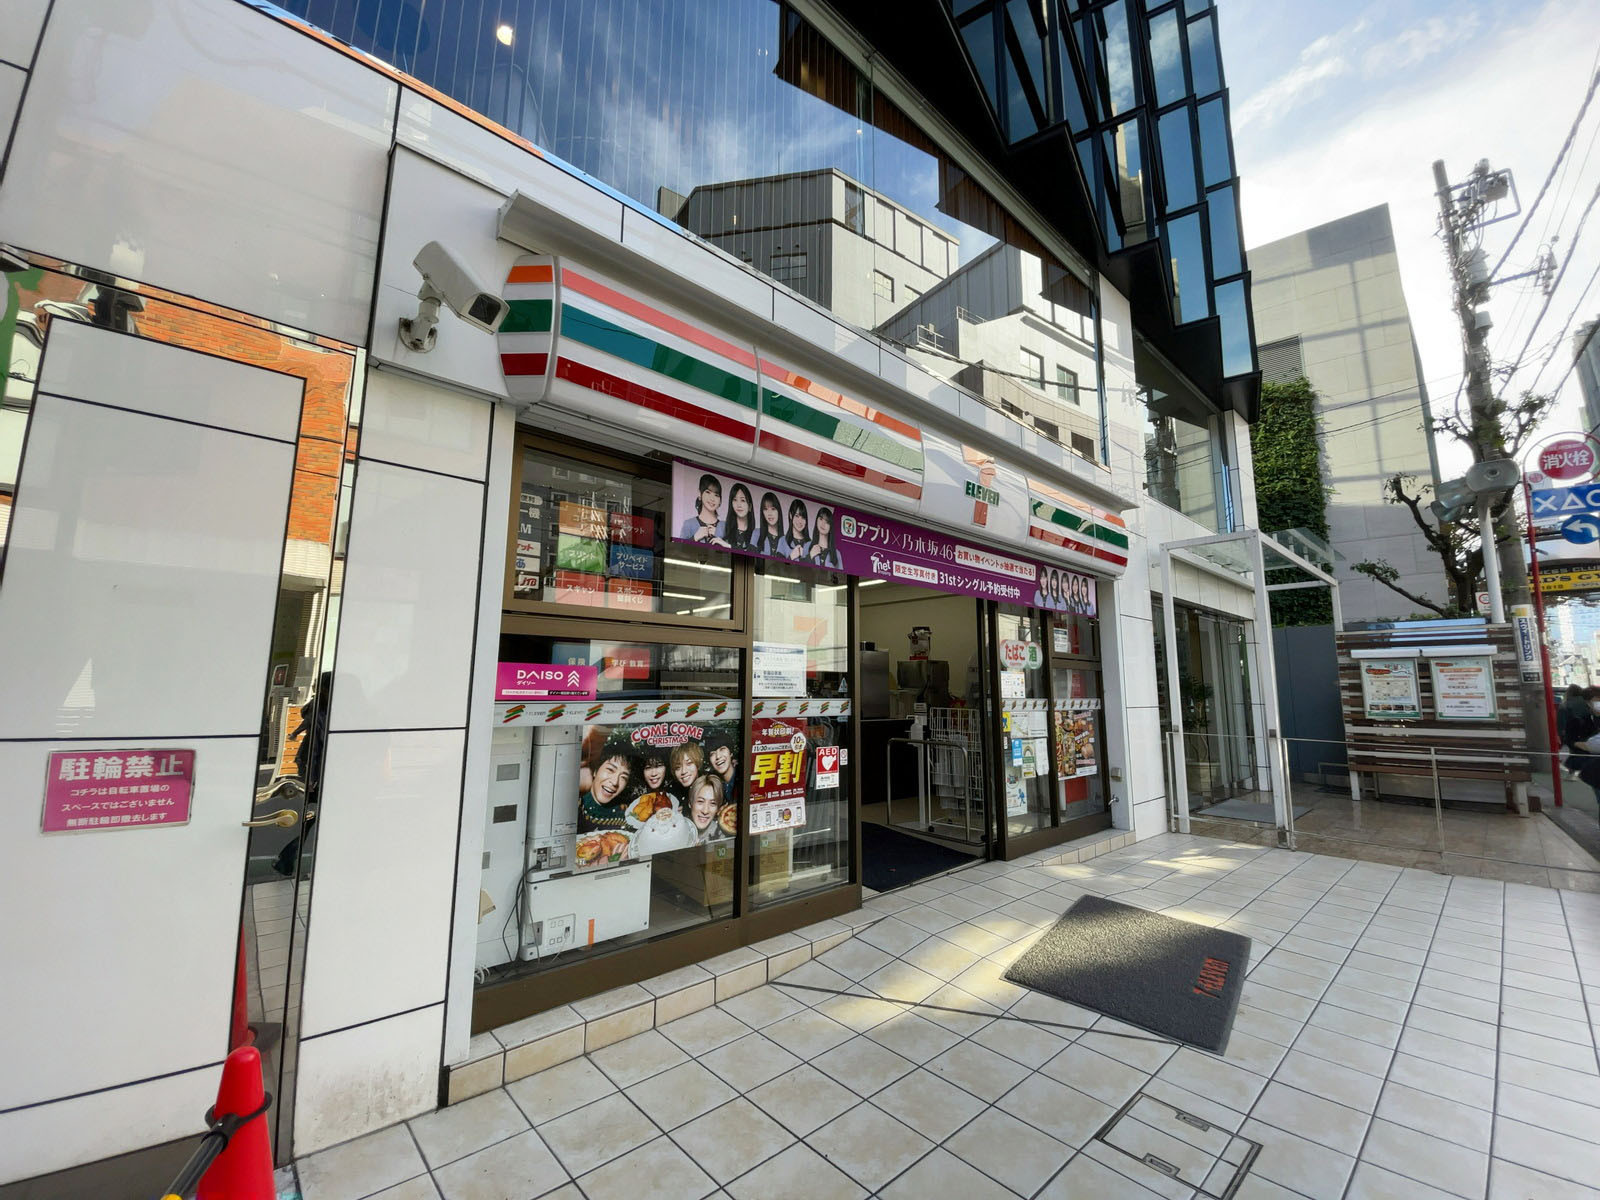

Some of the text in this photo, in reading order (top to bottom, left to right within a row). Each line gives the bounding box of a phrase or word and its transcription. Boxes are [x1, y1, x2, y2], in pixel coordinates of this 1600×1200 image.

[1543, 449, 1590, 470] 消火栓
[616, 552, 648, 563] プリペイド
[618, 561, 645, 571] サービス
[520, 577, 537, 587] JTB
[939, 572, 1021, 600] 31stシングル予約受付中
[567, 584, 594, 593] スキャン
[617, 586, 645, 596] スポーツ
[1005, 644, 1026, 661] たばこ
[517, 670, 564, 680] DAISO
[631, 723, 703, 743] COME COME
[647, 735, 689, 746] CHRISTMAS
[818, 747, 837, 756] AED
[58, 754, 184, 781] 駐輪禁止
[750, 750, 803, 788] 早割
[61, 798, 175, 812] スペースではございません
